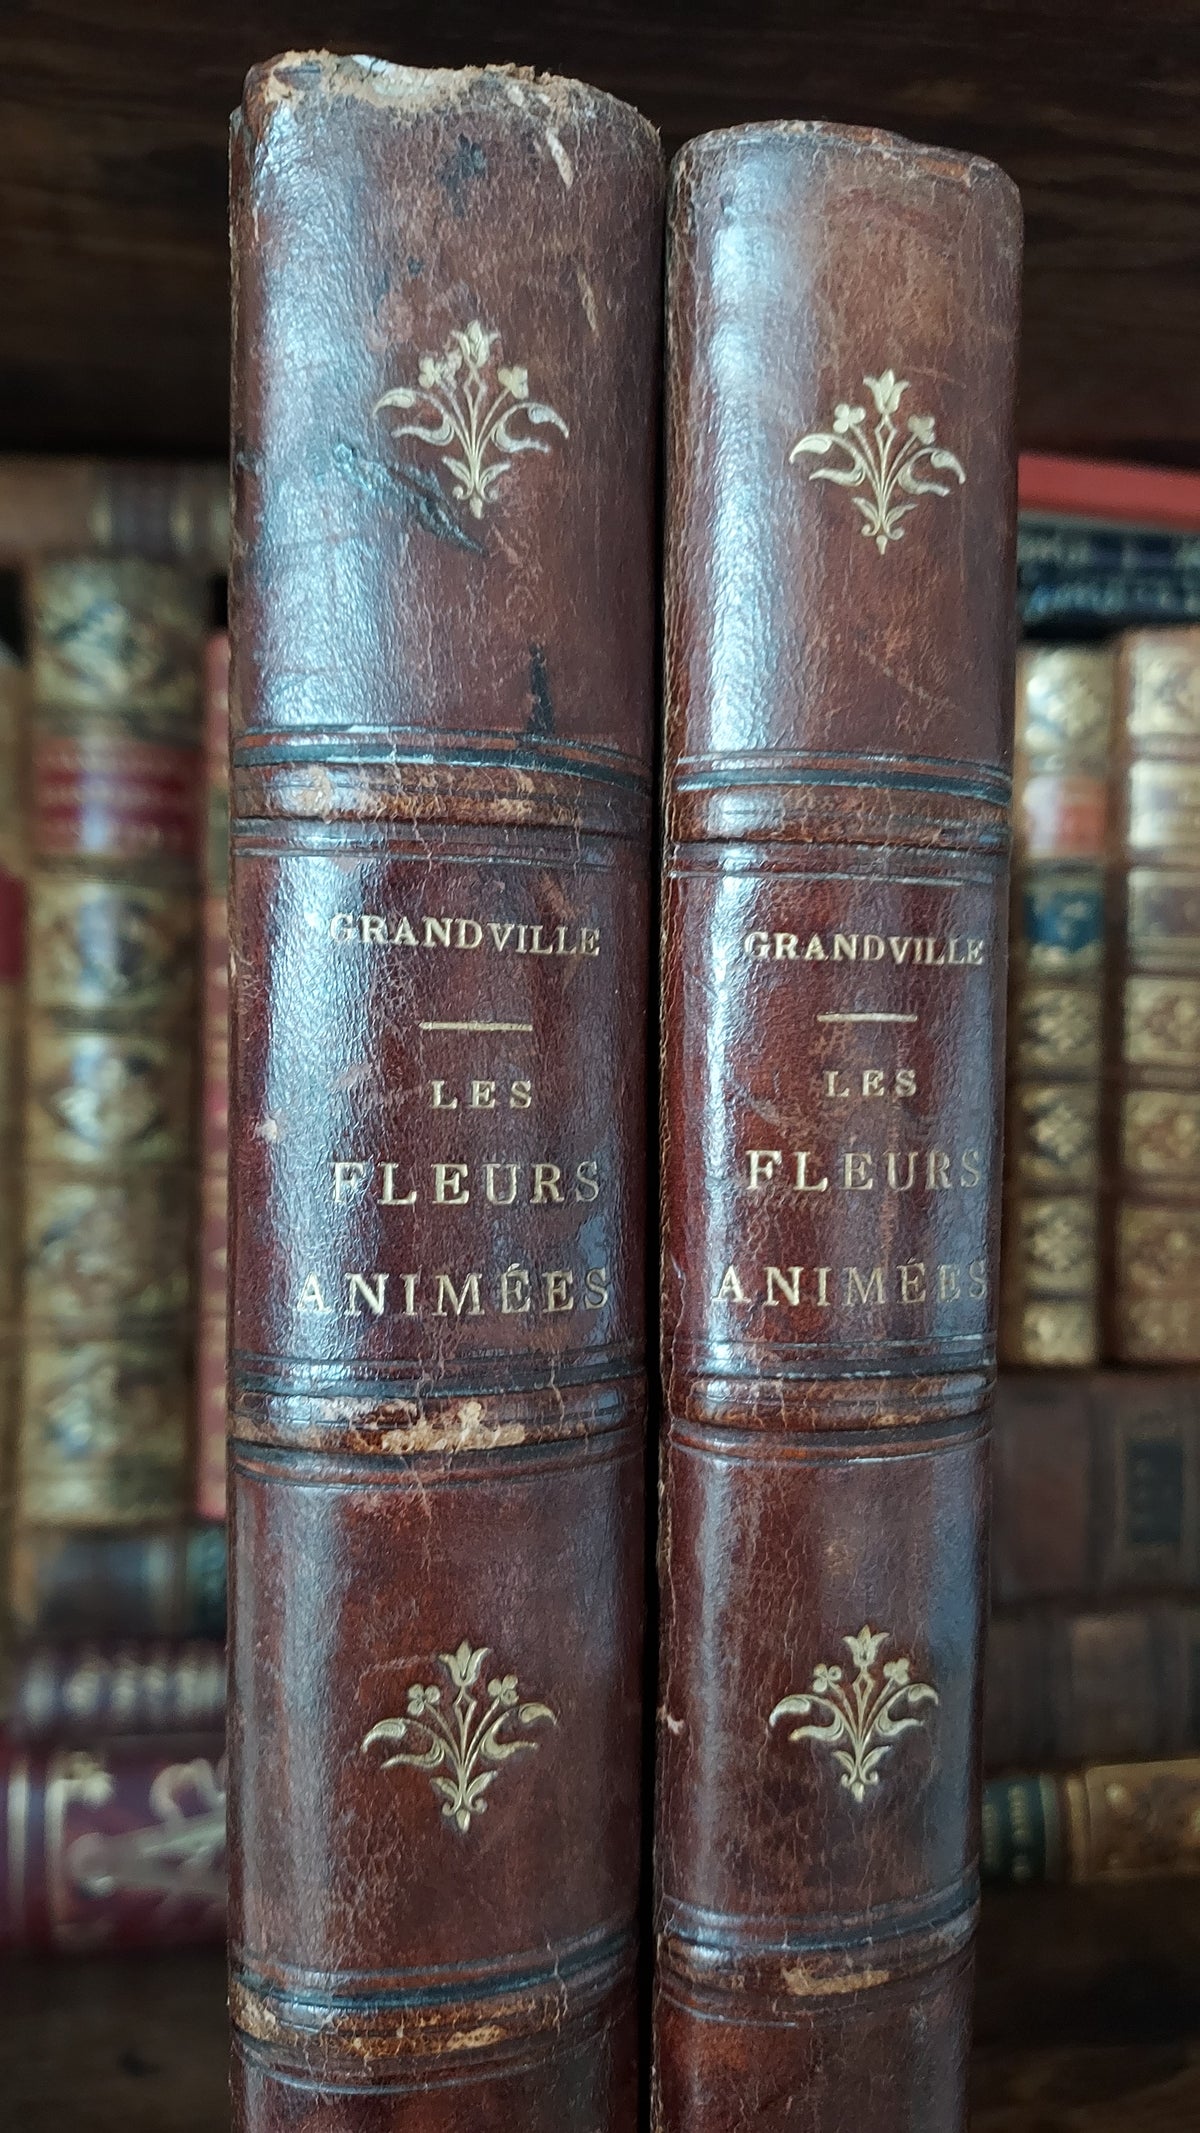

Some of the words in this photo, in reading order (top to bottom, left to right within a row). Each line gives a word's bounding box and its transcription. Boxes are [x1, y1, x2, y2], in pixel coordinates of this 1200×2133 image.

[329, 912, 601, 957] GRANDVILLE
[743, 931, 984, 966] GRANDVILLE
[430, 1080, 532, 1110] LES
[823, 1069, 918, 1098] LES
[329, 1160, 601, 1206] FLEURS
[745, 1149, 982, 1193] FLEURS
[294, 1263, 610, 1317] ANIMÉES
[712, 1257, 988, 1307] ANIMÉES
